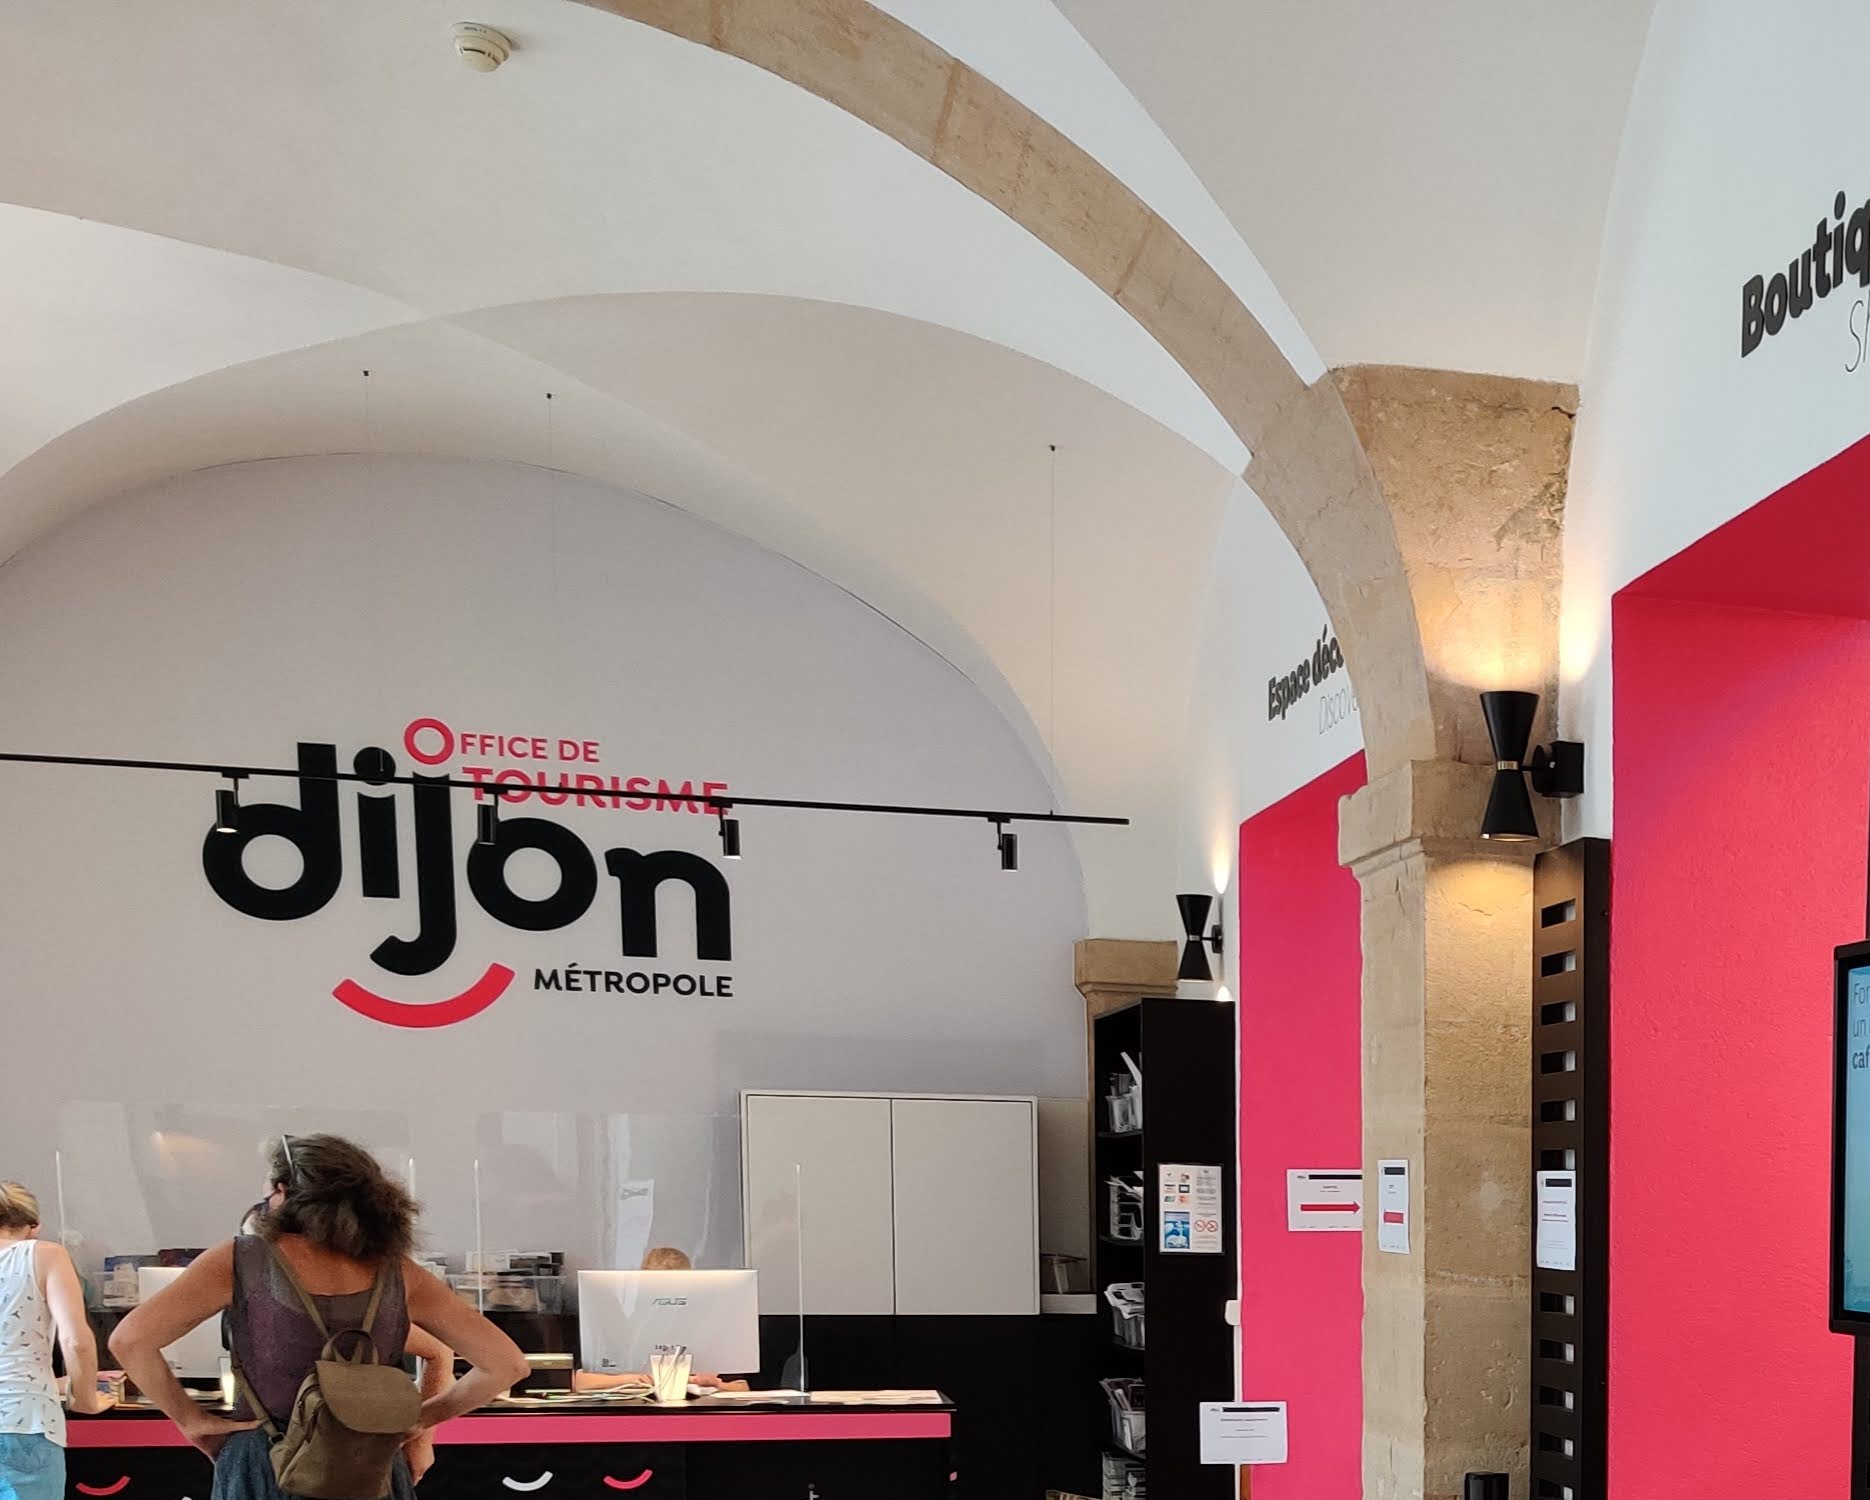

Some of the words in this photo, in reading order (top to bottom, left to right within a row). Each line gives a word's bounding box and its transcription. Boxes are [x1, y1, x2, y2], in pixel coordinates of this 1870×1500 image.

[1268, 658, 1311, 721] Espace
[403, 717, 547, 765] OFFICE
[558, 739, 600, 763] DE
[461, 765, 730, 816] TOURISME
[203, 741, 732, 977] dijon
[533, 962, 734, 998] MÉTROPOLE
[1853, 1018, 1867, 1037] un
